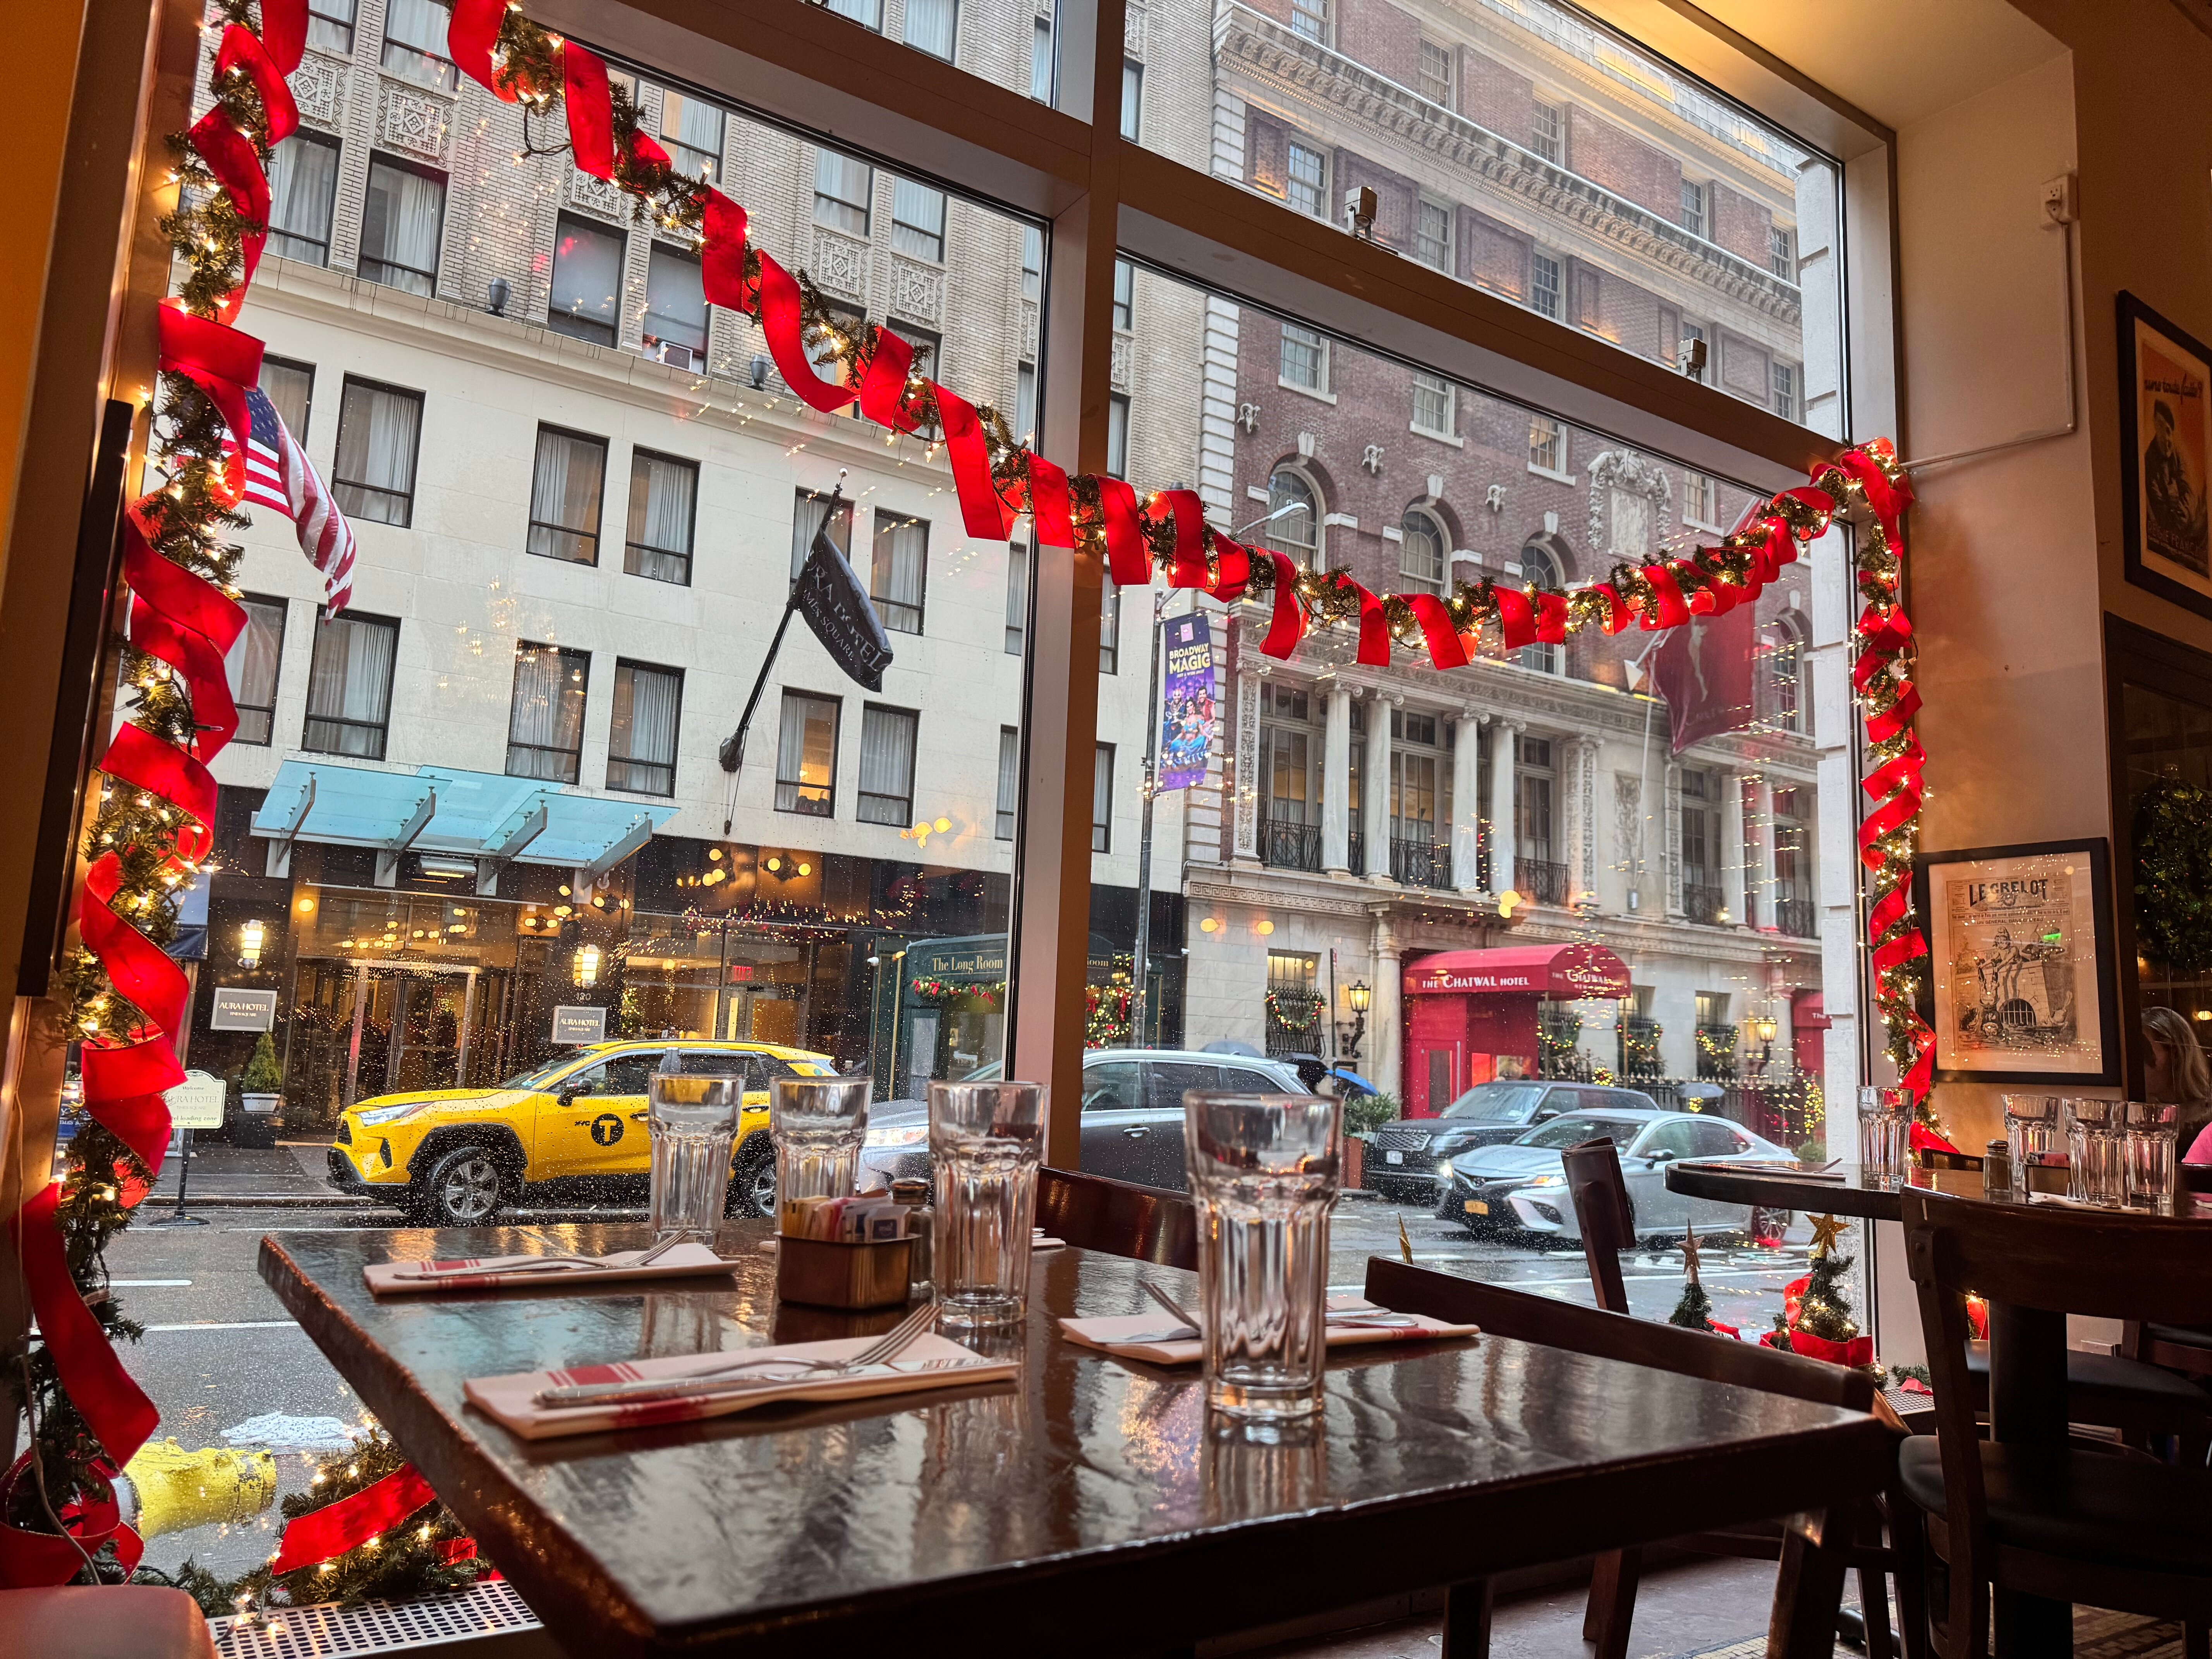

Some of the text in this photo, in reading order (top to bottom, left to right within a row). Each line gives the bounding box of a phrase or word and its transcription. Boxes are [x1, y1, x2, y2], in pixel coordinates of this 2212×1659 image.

[1170, 643, 1209, 659] BROADWAY
[1170, 653, 1211, 674] MAGIC
[1969, 883, 1986, 907] LE
[1990, 879, 2048, 900] GRELOT
[933, 956, 1003, 974] The Long Room
[1087, 956, 1109, 967] oom
[1422, 974, 1530, 988] THE CHATWAL HOTEL
[219, 1001, 269, 1012] AURA HOTEL
